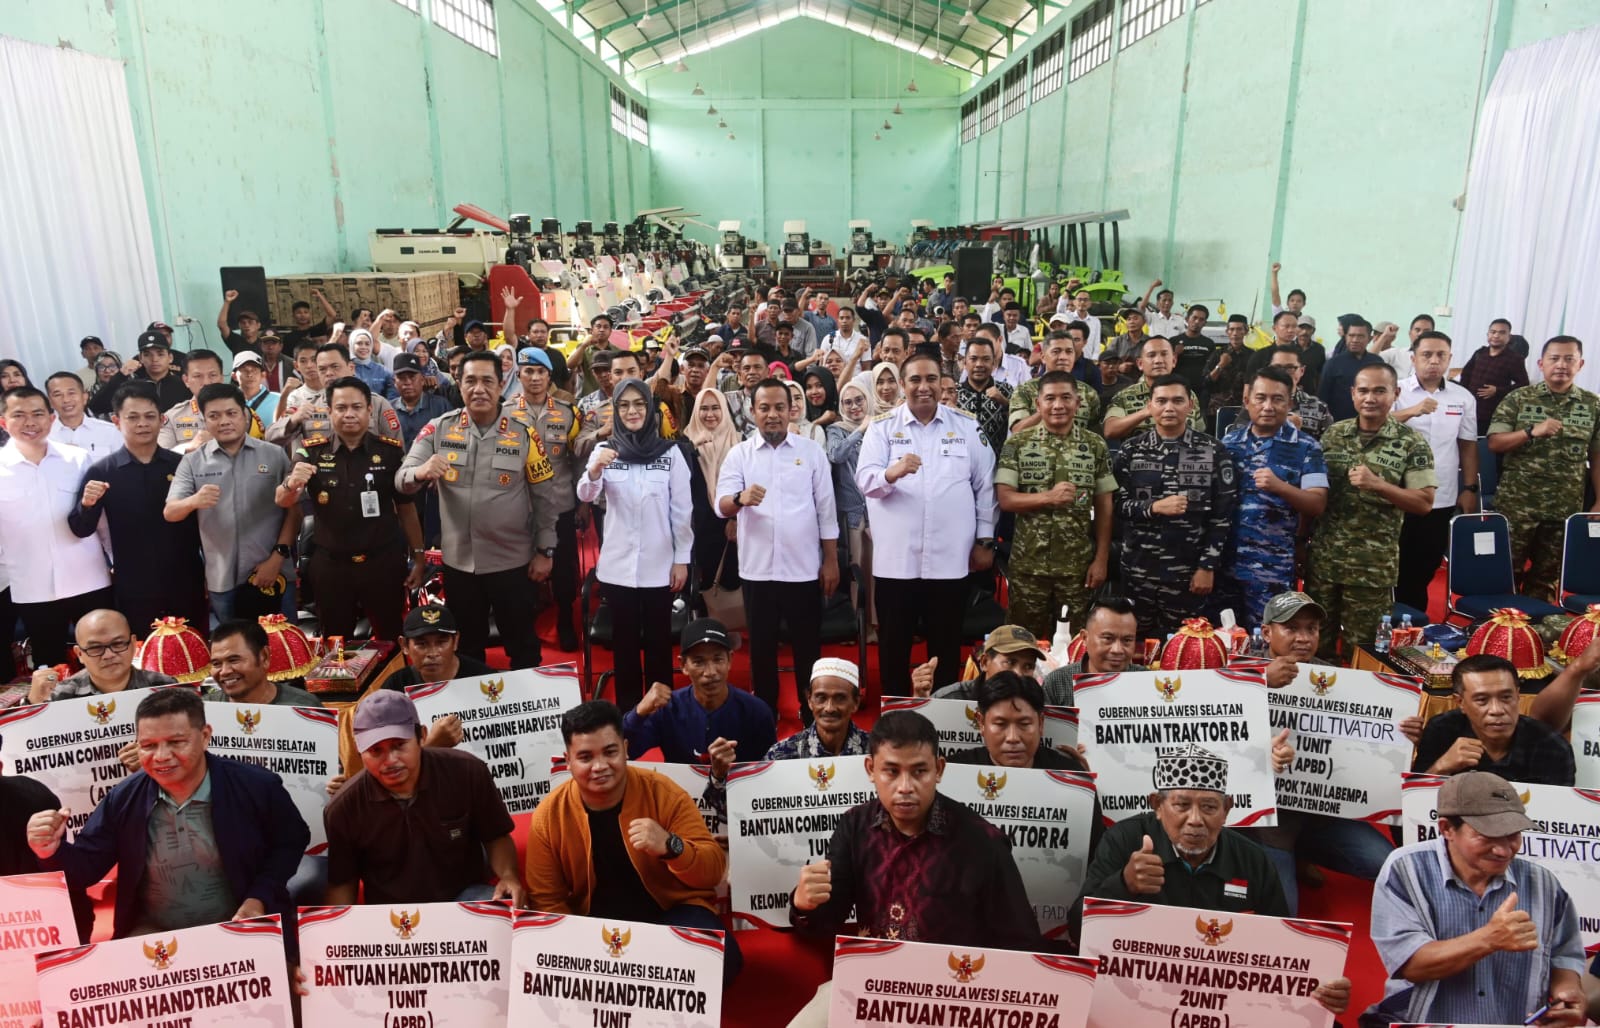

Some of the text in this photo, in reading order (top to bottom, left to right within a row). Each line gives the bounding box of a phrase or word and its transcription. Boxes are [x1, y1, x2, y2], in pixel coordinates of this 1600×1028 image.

[496, 447, 520, 456] POLRI
[1376, 456, 1401, 469] TNI AD
[478, 702, 521, 718] SULAWESI
[522, 697, 560, 711] SELATAN
[1099, 703, 1243, 718] GUBERNUR SULAWESI SELATAN
[1300, 697, 1348, 713] SULAWESI
[1349, 702, 1393, 718] SELATAN
[26, 723, 135, 750] GUBERNUR SULAWESI
[472, 721, 517, 740] COMBINE
[519, 714, 563, 734] HARVEST
[1095, 721, 1249, 744] BANTUAN TRAKTOR R4
[1299, 713, 1394, 741] CULTIVATOR
[231, 737, 275, 750] SULAWESI
[277, 740, 316, 752] SELATAN
[15, 751, 75, 774] BANTUAN
[270, 757, 327, 776] HARVESTER
[513, 784, 533, 799] BULU
[751, 796, 803, 810] GUBERNUR
[804, 793, 852, 807] SULAWESI
[1300, 781, 1323, 797] TANI
[1324, 784, 1368, 804] LABEMPA
[1021, 806, 1067, 821] SELATAN
[1276, 794, 1341, 814] ABUPATEN BONE
[740, 815, 794, 836] BANTUAN
[796, 813, 842, 832] COMBIN
[1049, 827, 1069, 849] R4
[750, 893, 790, 910] KELOMP
[326, 940, 487, 958] GUBERNUR SULAWESI SELATAN
[1112, 938, 1310, 971] GUBERNUR SULAWESI SELATAN
[69, 958, 256, 1001] GUBERNUR SULAWESI SELATAN
[315, 959, 500, 986] BANTUAN HANDTRAKTOR
[536, 953, 695, 983] GUBERNUR SULAWESI SELATAN
[1098, 954, 1183, 984] BANTUAN
[57, 976, 272, 1028] BANTUAN HANDTRAKTOR
[523, 971, 706, 1014] BANTUAN HANDTRAKTOR
[865, 978, 1059, 1007] GUBERNUR SULAWESI SELATAN
[856, 998, 1060, 1028] BANTUAN TRAKTOR R4
